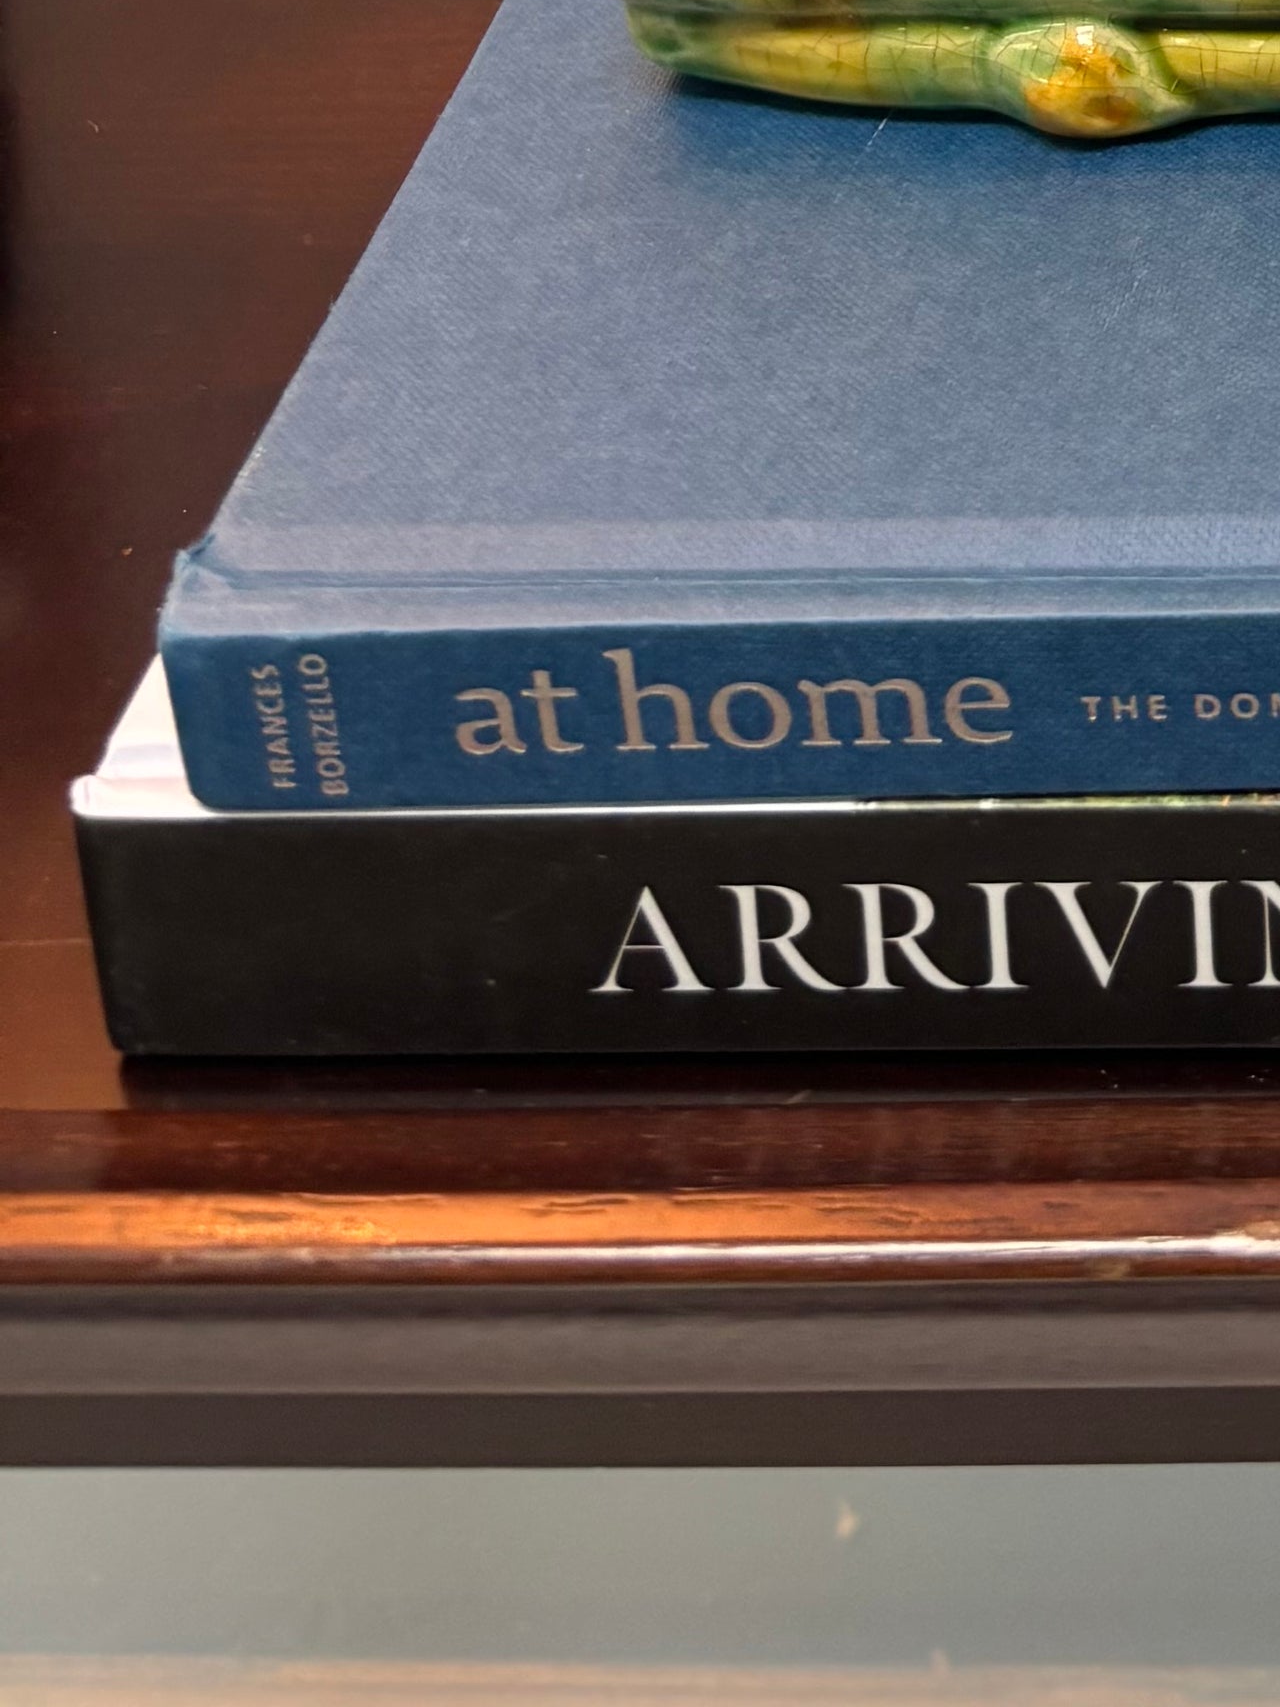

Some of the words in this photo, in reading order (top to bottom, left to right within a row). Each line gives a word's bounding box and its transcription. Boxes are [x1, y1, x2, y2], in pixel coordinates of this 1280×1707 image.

[251, 664, 297, 788] FRANCES
[298, 653, 349, 796] BORZELLO
[455, 669, 584, 756] at
[603, 648, 1013, 752] home
[1082, 694, 1168, 722] THE
